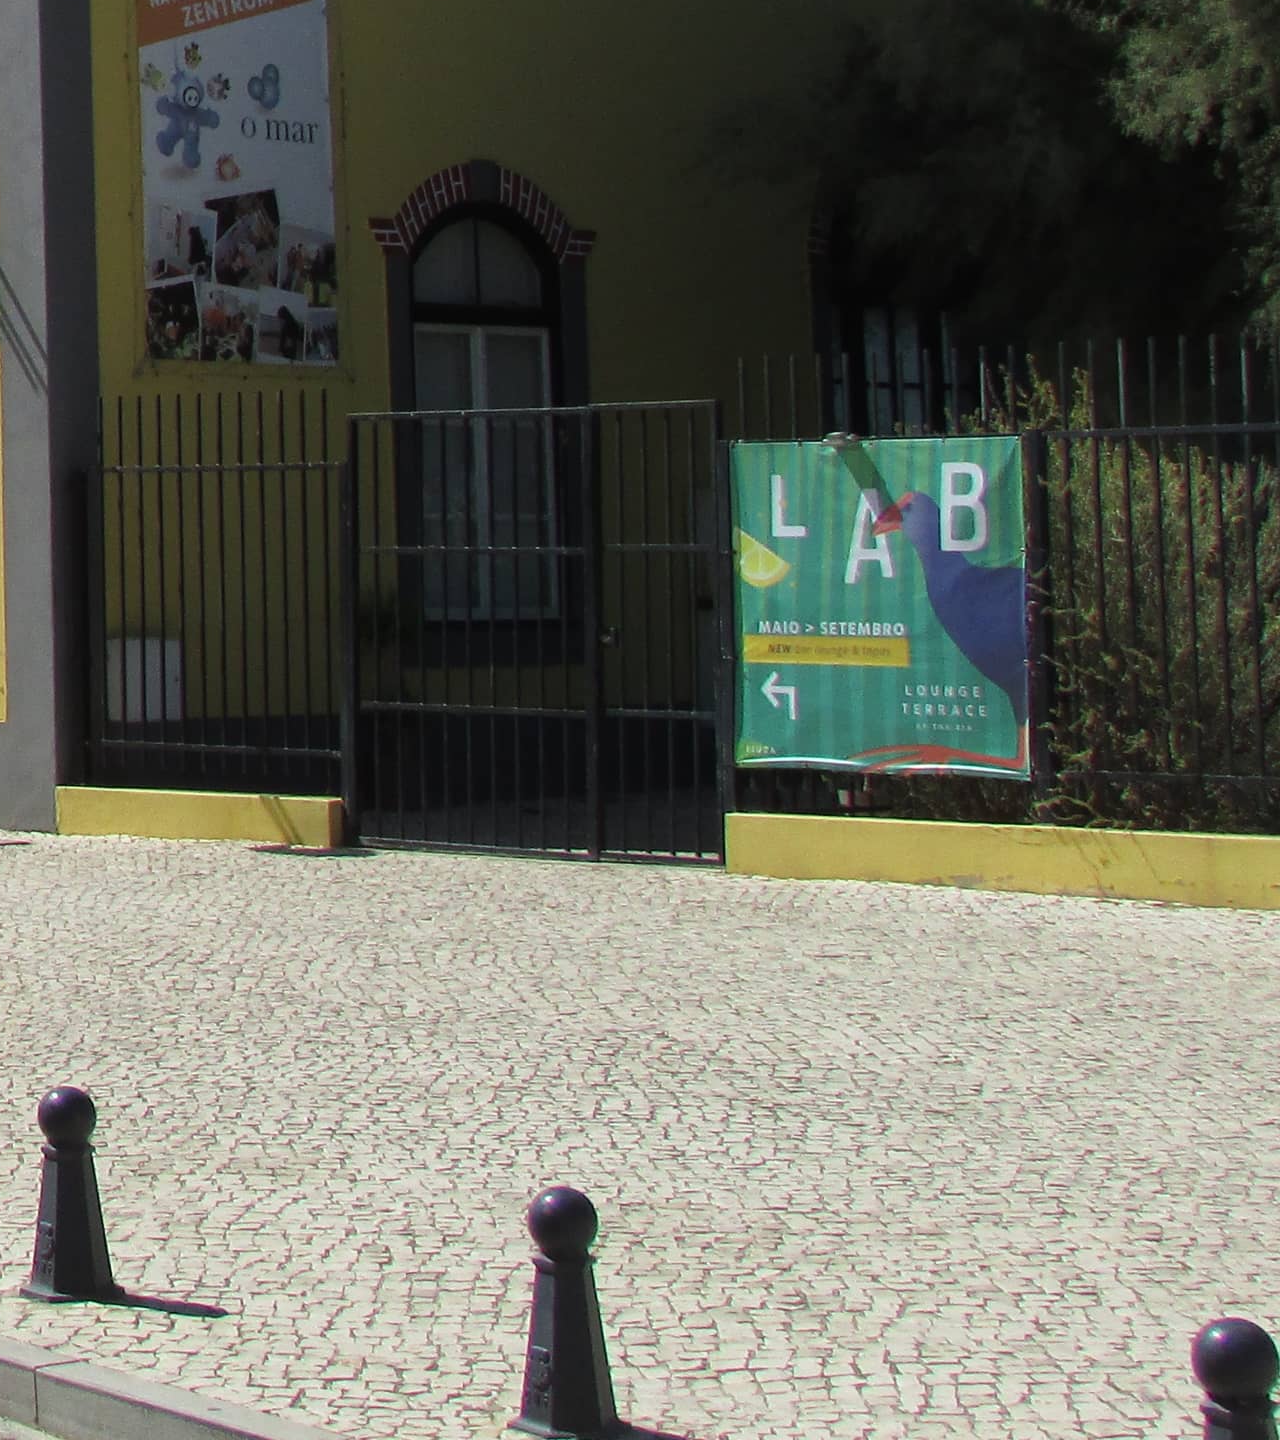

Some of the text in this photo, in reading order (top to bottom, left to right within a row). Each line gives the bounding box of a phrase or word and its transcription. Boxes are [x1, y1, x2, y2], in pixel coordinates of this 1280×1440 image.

[241, 116, 319, 145] o mar
[771, 461, 990, 586] LAB
[758, 620, 801, 635] MAIO
[819, 621, 906, 637] SETEMBRO
[767, 643, 791, 654] NEW
[904, 683, 982, 698] LOUNGE
[902, 702, 988, 717] TERRACE
